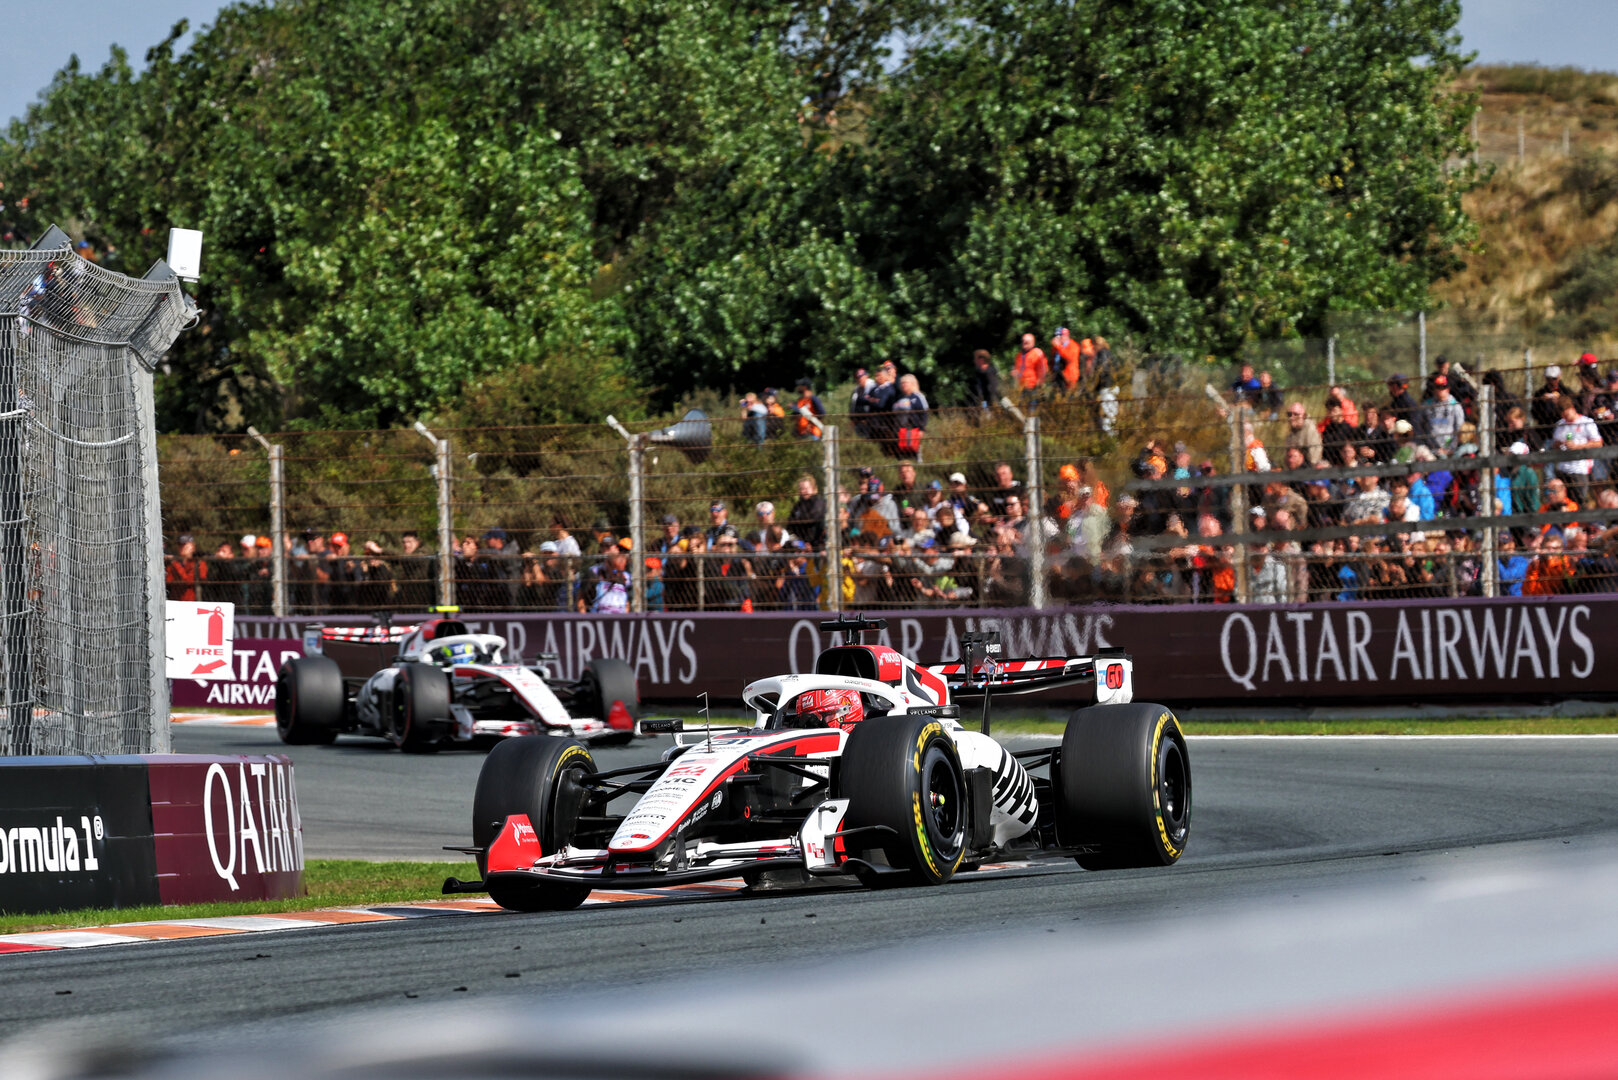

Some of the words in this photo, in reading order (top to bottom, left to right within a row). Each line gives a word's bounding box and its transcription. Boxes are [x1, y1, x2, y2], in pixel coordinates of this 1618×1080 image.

[186, 648, 223, 656] FIRE
[544, 619, 697, 684] AIRWAYS
[940, 613, 1114, 662] AWAYS
[1220, 610, 1378, 690] QATAR
[1390, 605, 1595, 680] AIRWAYS
[206, 683, 277, 704] AIRWA
[1106, 663, 1123, 689] GO
[916, 722, 941, 754] ZERO
[204, 762, 294, 891] QATAR
